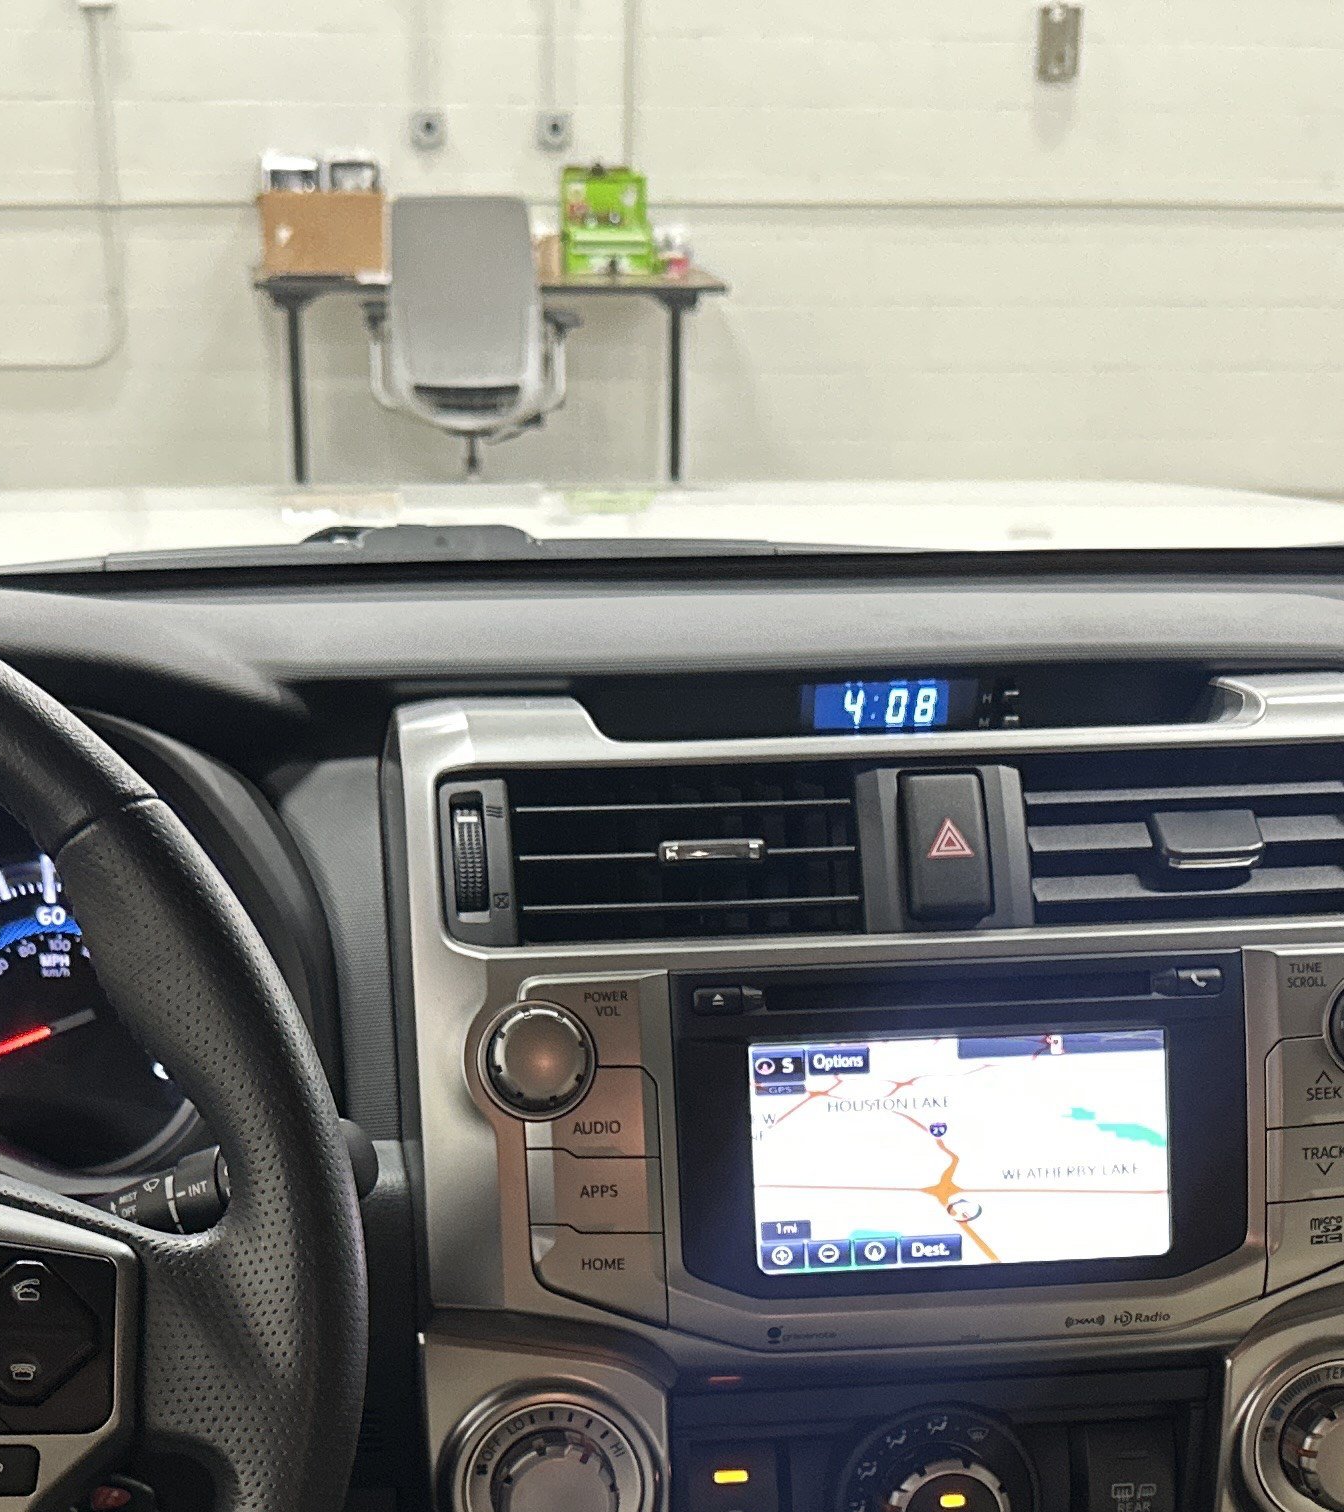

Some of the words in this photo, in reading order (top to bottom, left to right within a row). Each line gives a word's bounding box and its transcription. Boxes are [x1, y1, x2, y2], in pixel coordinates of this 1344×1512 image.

[843, 688, 938, 727] 4:08
[35, 905, 66, 926] 60
[1289, 962, 1323, 974] TUNE
[1287, 976, 1327, 988] SCROLL
[584, 990, 628, 1003] POWER
[595, 1006, 621, 1018] VOL
[782, 1058, 794, 1073] S
[813, 1054, 864, 1072] Options
[1306, 1086, 1342, 1101] SEEK
[827, 1097, 908, 1112] HOUSTON
[573, 1120, 621, 1135] AUDIO
[1002, 1165, 1097, 1180] WEATHERBY
[188, 1180, 207, 1197] INT
[580, 1184, 618, 1198] APPS
[1310, 1216, 1343, 1230] micro
[911, 1242, 950, 1258] Dest.
[581, 1258, 625, 1271] HOME
[1135, 1312, 1171, 1323] Radio
